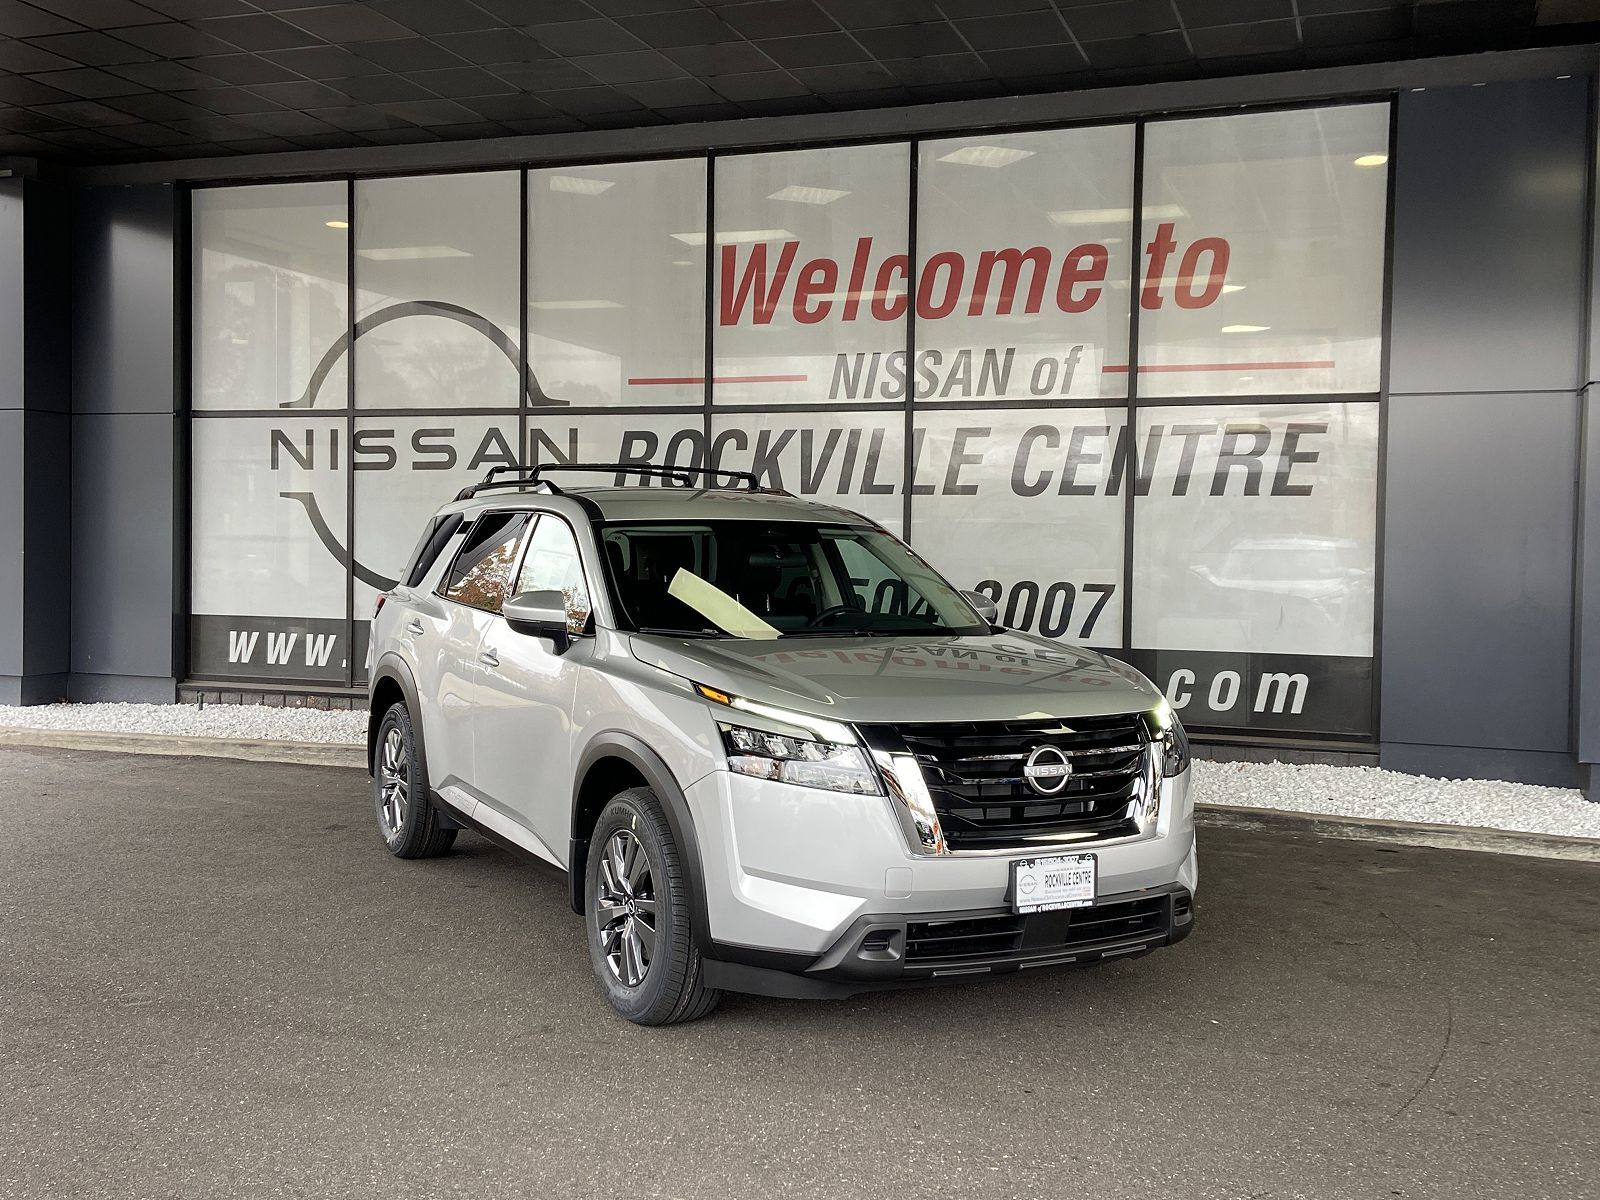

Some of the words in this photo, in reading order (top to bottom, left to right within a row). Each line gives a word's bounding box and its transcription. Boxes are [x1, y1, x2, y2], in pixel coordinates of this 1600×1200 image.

[720, 237, 1107, 325] Welcome
[1138, 223, 1231, 310] to
[829, 346, 1015, 400] NISSAN
[1030, 345, 1085, 395] of
[270, 427, 578, 471] NISSAN
[614, 424, 991, 496] ROCKVILLE
[1010, 421, 1328, 498] CENTRE
[1026, 765, 1073, 777] NISSAN
[1044, 872, 1072, 888] ROCKVILLE
[1072, 870, 1092, 885] CENTRE
